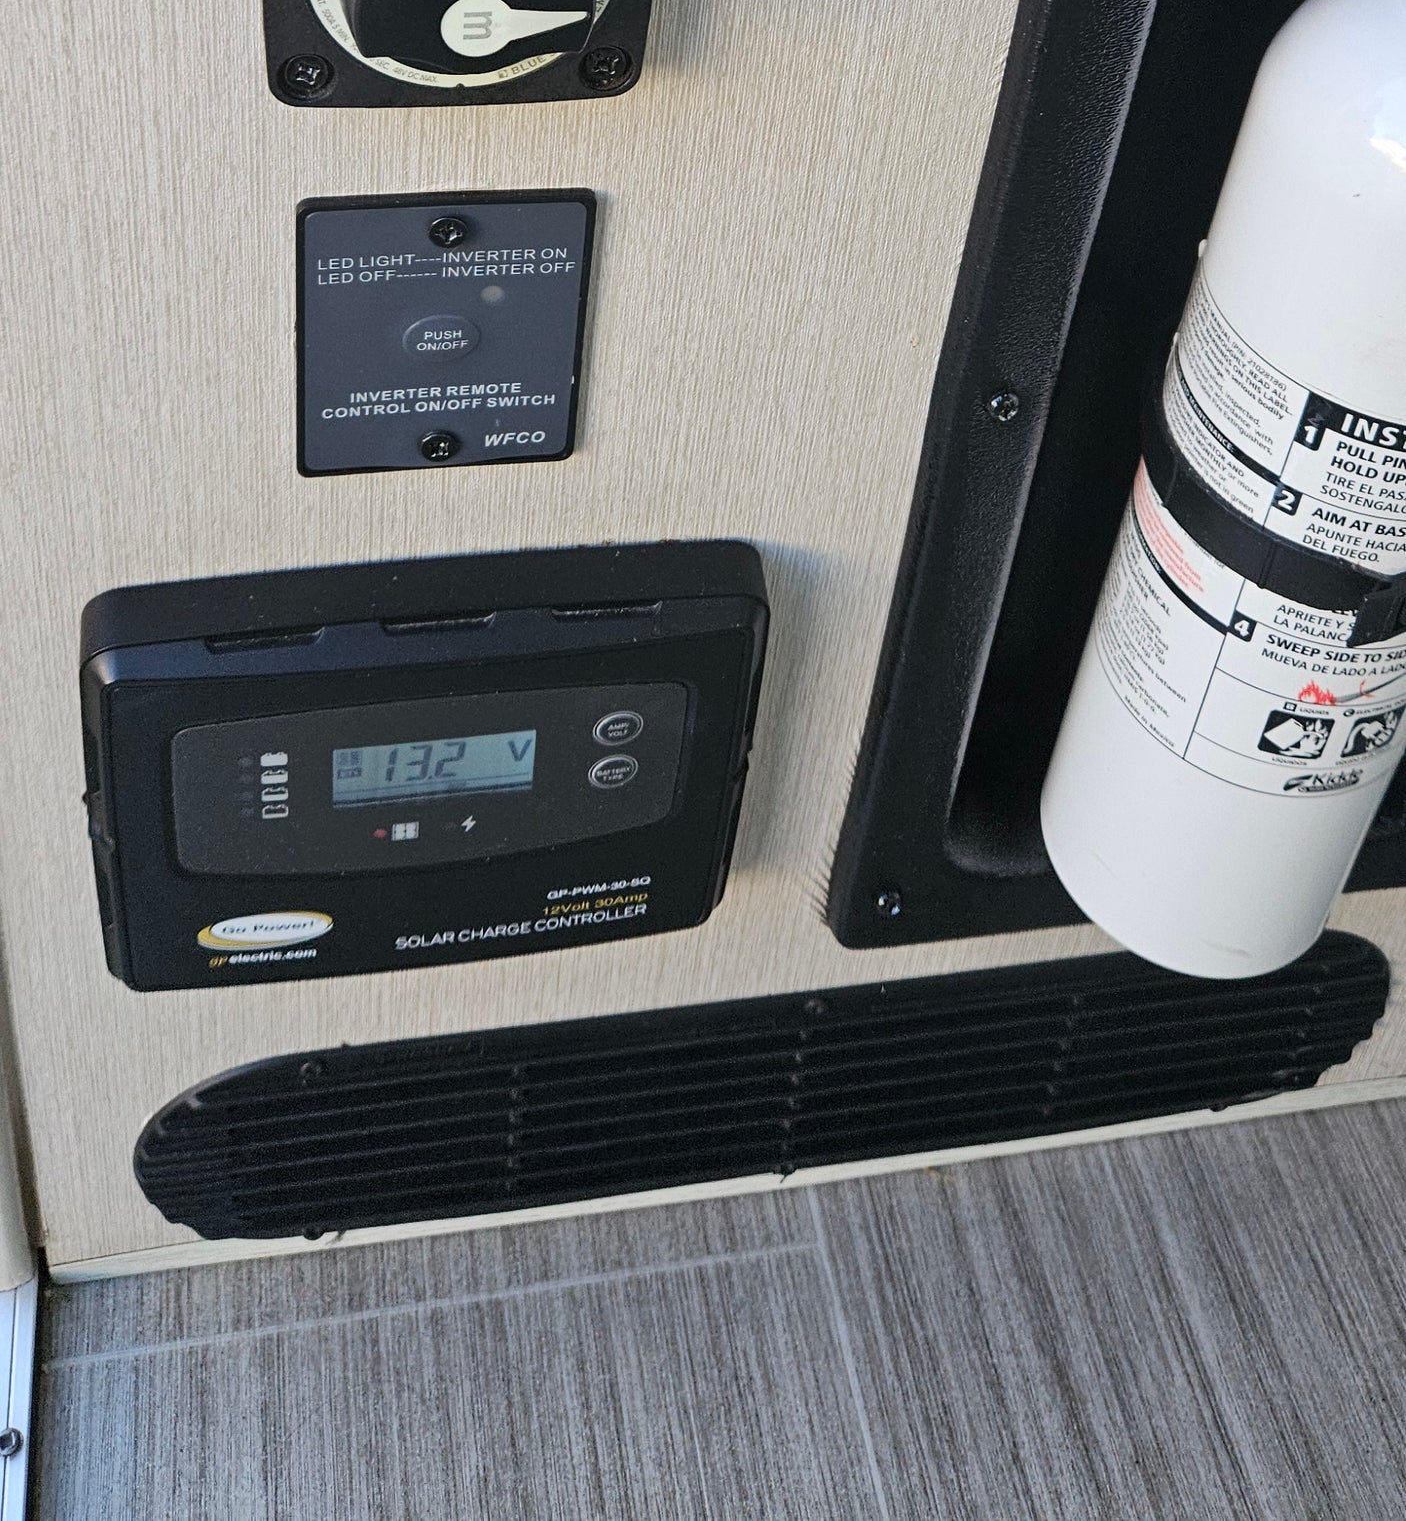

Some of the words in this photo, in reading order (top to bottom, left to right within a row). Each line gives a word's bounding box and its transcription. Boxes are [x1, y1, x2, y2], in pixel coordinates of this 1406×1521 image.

[318, 257, 354, 270] LED
[541, 247, 567, 259] ON
[318, 272, 353, 285] LED
[442, 263, 535, 278] INVERTER
[540, 261, 576, 274] OFF
[417, 339, 469, 351] ON/OFF
[424, 329, 462, 340] PUSH
[1204, 327, 1233, 366] WARNINGS
[1232, 364, 1244, 378] ON
[1244, 376, 1263, 393] THIS
[350, 386, 441, 403] INVERTER
[447, 382, 522, 395] REMOTE
[1230, 373, 1257, 400] serious
[1257, 397, 1284, 421] bodily
[1247, 369, 1270, 389] READ
[1272, 388, 1289, 402] ALL
[322, 403, 411, 419] CONTROL
[415, 398, 482, 412] ON/OFF
[487, 394, 555, 408] SWITCH
[1213, 390, 1252, 429] accordance
[1253, 428, 1274, 445] with
[1224, 391, 1262, 428] inspected,
[484, 430, 546, 447] WFCO
[1304, 425, 1318, 445] 1
[1336, 440, 1376, 463] PULL
[1226, 460, 1245, 477] AND
[1331, 456, 1378, 479] HOLD
[1383, 471, 1406, 485] UP
[1237, 479, 1259, 497] more
[1325, 471, 1355, 490] TIRE
[1358, 481, 1375, 496] EL
[1379, 488, 1406, 501] PAS
[1231, 493, 1254, 514] green
[1275, 489, 1292, 510] 2
[1312, 508, 1346, 527] AIM
[1349, 519, 1372, 532] AT
[1305, 523, 1362, 546] APUNTE
[1302, 534, 1327, 551] DEL
[1331, 544, 1380, 563] FUEGO.
[1138, 566, 1170, 617] CHEMICAL
[1273, 615, 1285, 628] LA
[1294, 623, 1348, 642] PALANC
[1277, 604, 1331, 626] APRIETE
[1336, 620, 1345, 629] Y
[1234, 620, 1250, 637] 4
[1267, 634, 1321, 657] SWEEP
[1324, 651, 1360, 663] SIDE
[1363, 653, 1382, 663] TO
[1261, 648, 1307, 670] MUEVA
[1312, 663, 1329, 674] DE
[1333, 667, 1366, 676] LADO
[1368, 668, 1377, 676] A
[1150, 723, 1175, 747] Mexico
[385, 741, 467, 782] 13.2
[508, 739, 532, 762] V
[542, 900, 590, 916] 12Volt
[595, 892, 648, 909] 30Amp
[395, 930, 455, 950] SOLAR
[458, 920, 531, 943] CHARGE
[534, 902, 647, 933] CONTROLLER
